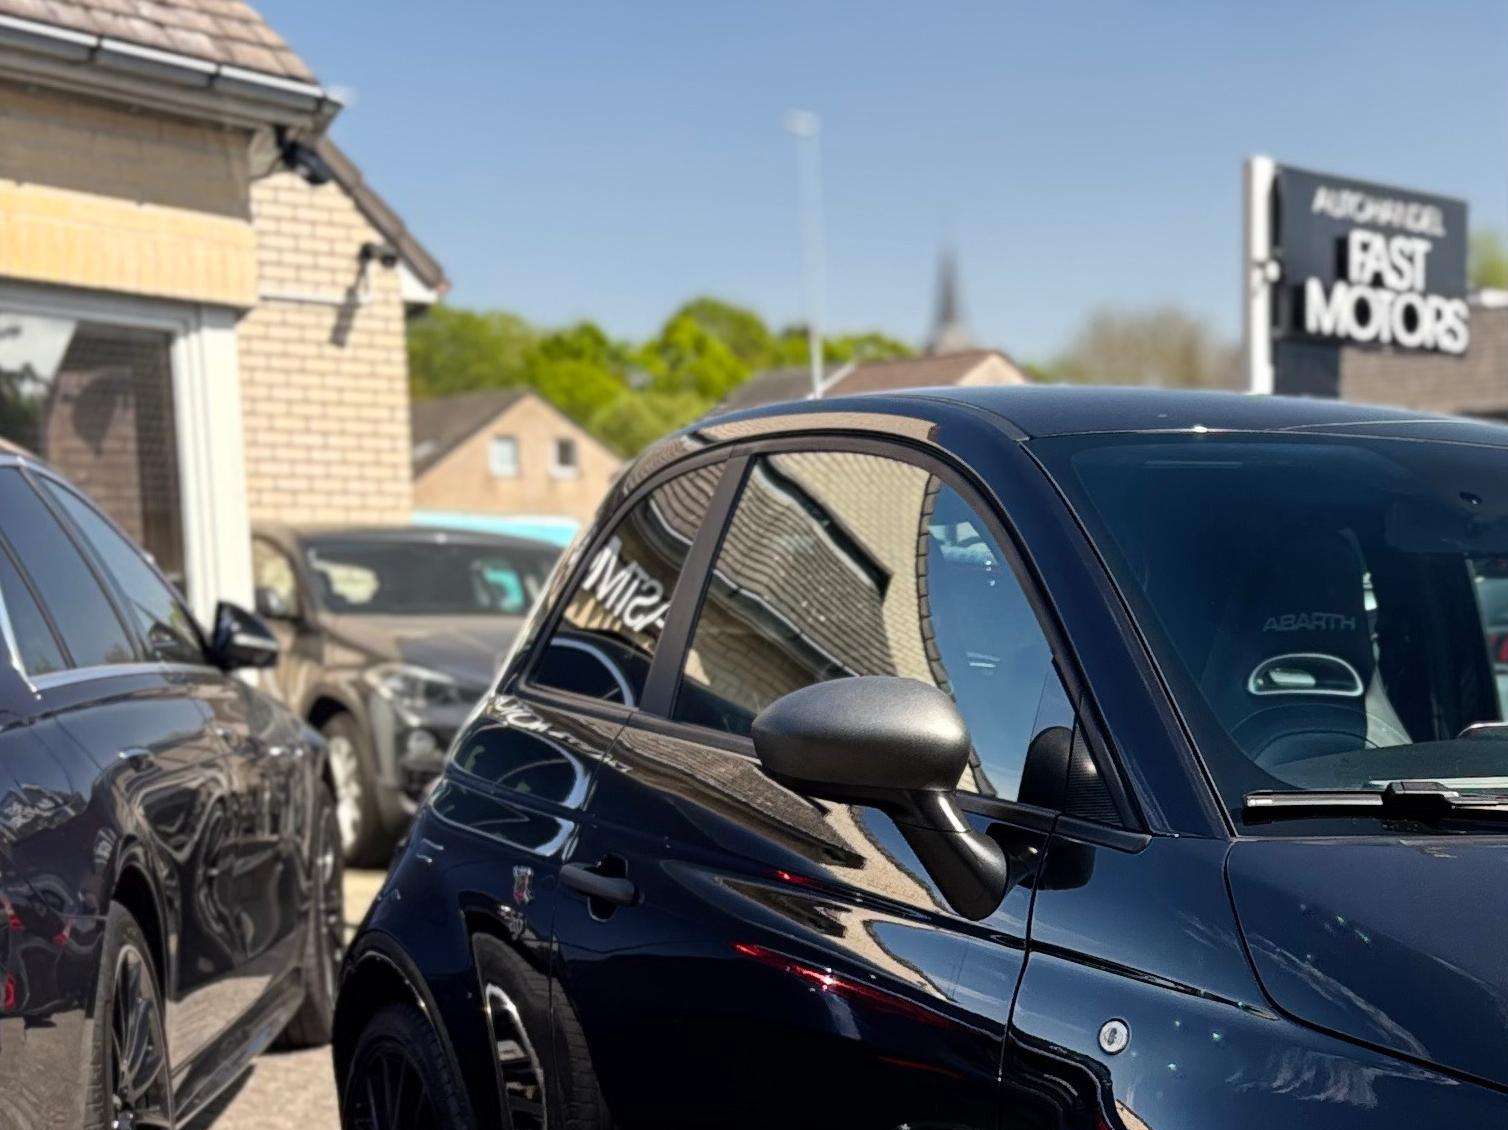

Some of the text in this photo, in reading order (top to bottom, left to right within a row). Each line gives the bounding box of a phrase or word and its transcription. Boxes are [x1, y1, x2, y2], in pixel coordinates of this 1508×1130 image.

[1348, 228, 1432, 293] FAST
[1305, 277, 1469, 353] MOTORS
[1263, 612, 1356, 632] ABARTH
